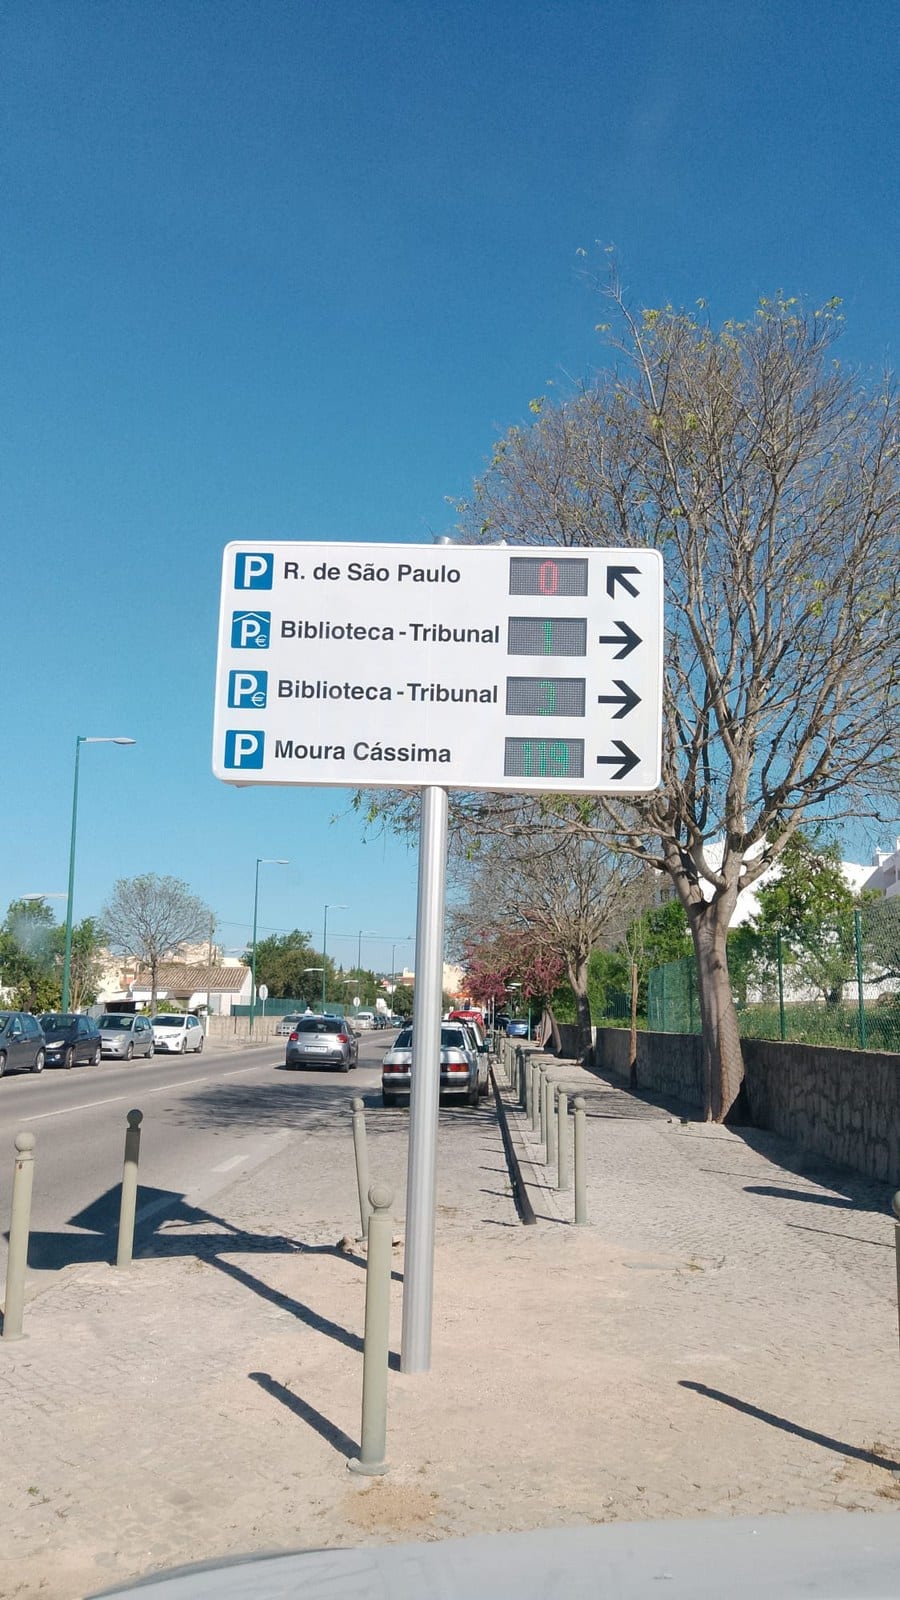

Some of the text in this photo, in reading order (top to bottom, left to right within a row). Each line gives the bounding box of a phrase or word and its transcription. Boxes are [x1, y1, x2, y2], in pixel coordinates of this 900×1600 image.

[284, 561, 461, 584] R. de São Paulo
[539, 560, 558, 595] 0
[542, 619, 553, 655] 1
[538, 680, 556, 716] 3
[274, 740, 451, 763] Moura Cássima
[522, 741, 568, 776] 119
